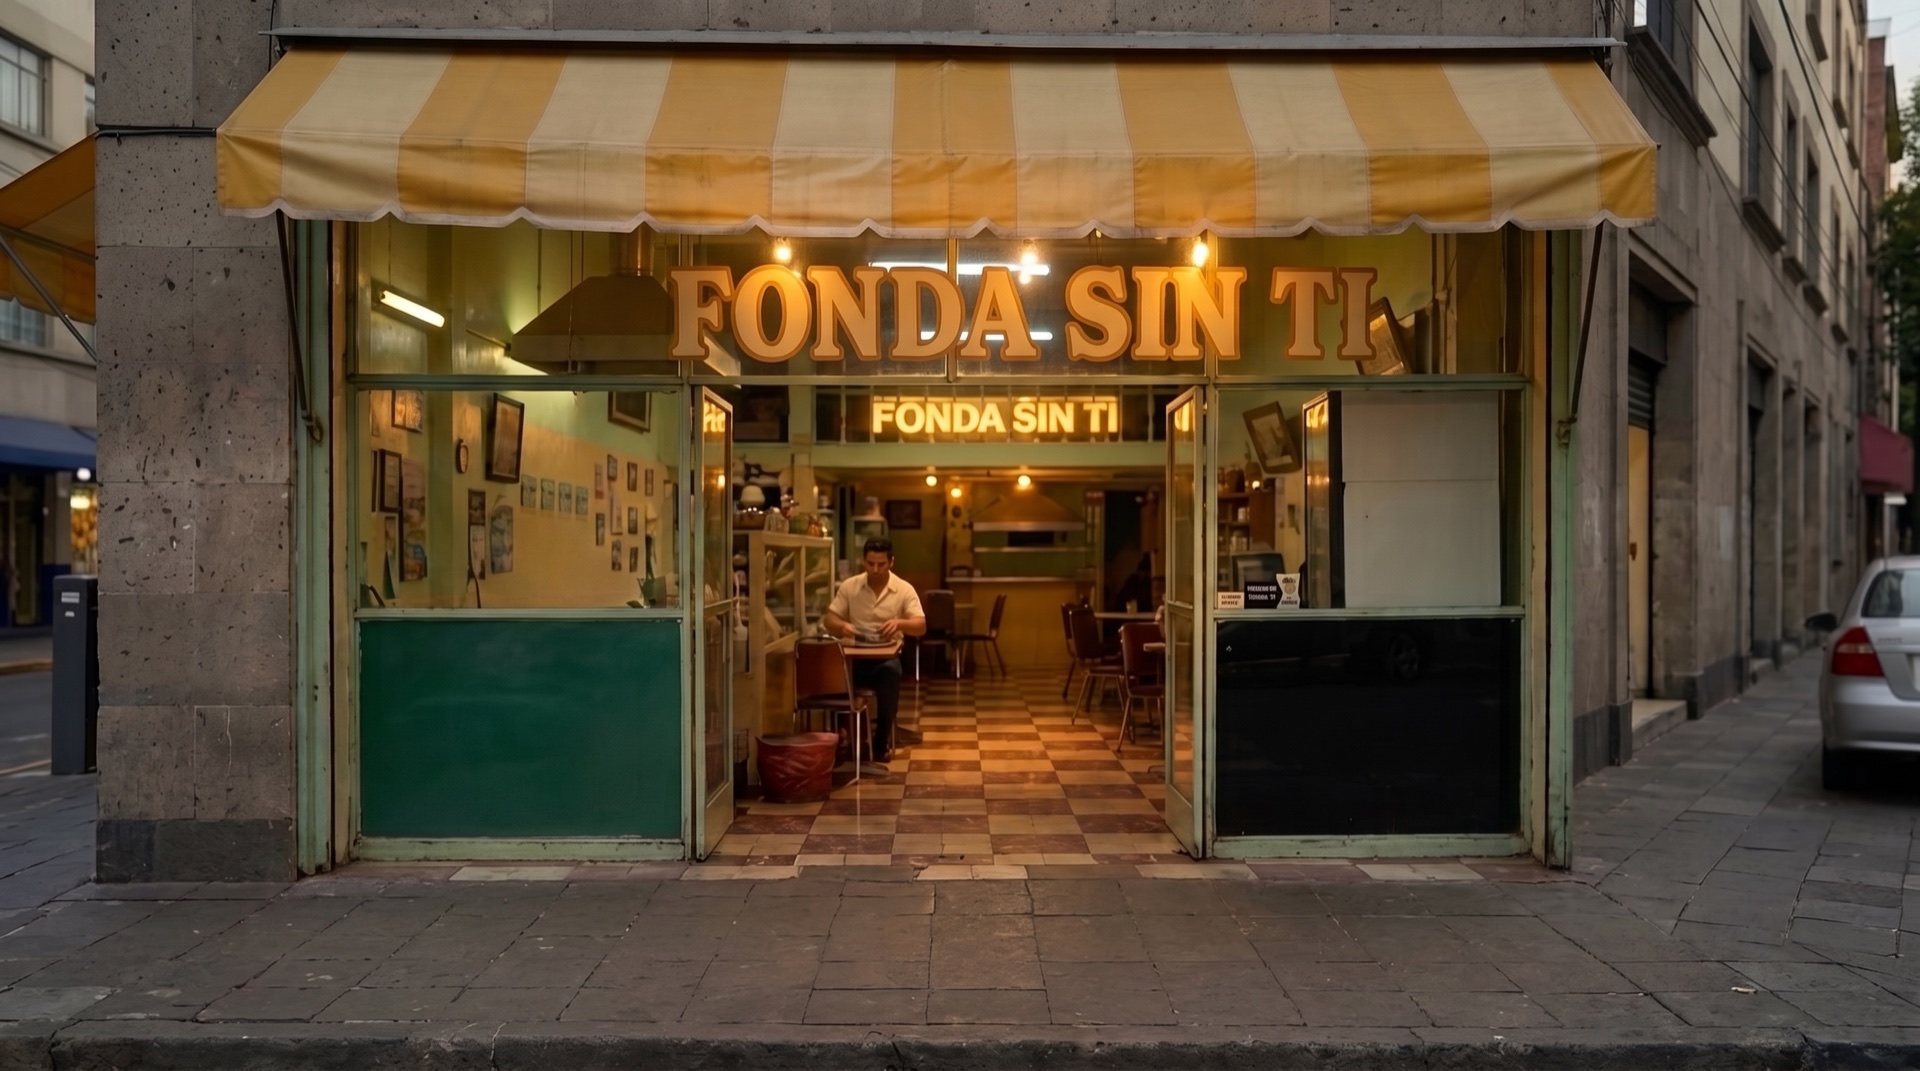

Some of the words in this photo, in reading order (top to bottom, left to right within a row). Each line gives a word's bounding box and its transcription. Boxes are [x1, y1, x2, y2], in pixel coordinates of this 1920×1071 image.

[669, 264, 1042, 363] FONDA
[1064, 264, 1248, 363] SIN
[1269, 265, 1378, 363] TI
[872, 402, 1007, 434] FONDA
[1012, 402, 1075, 434] SIN
[1083, 402, 1118, 433] TI
